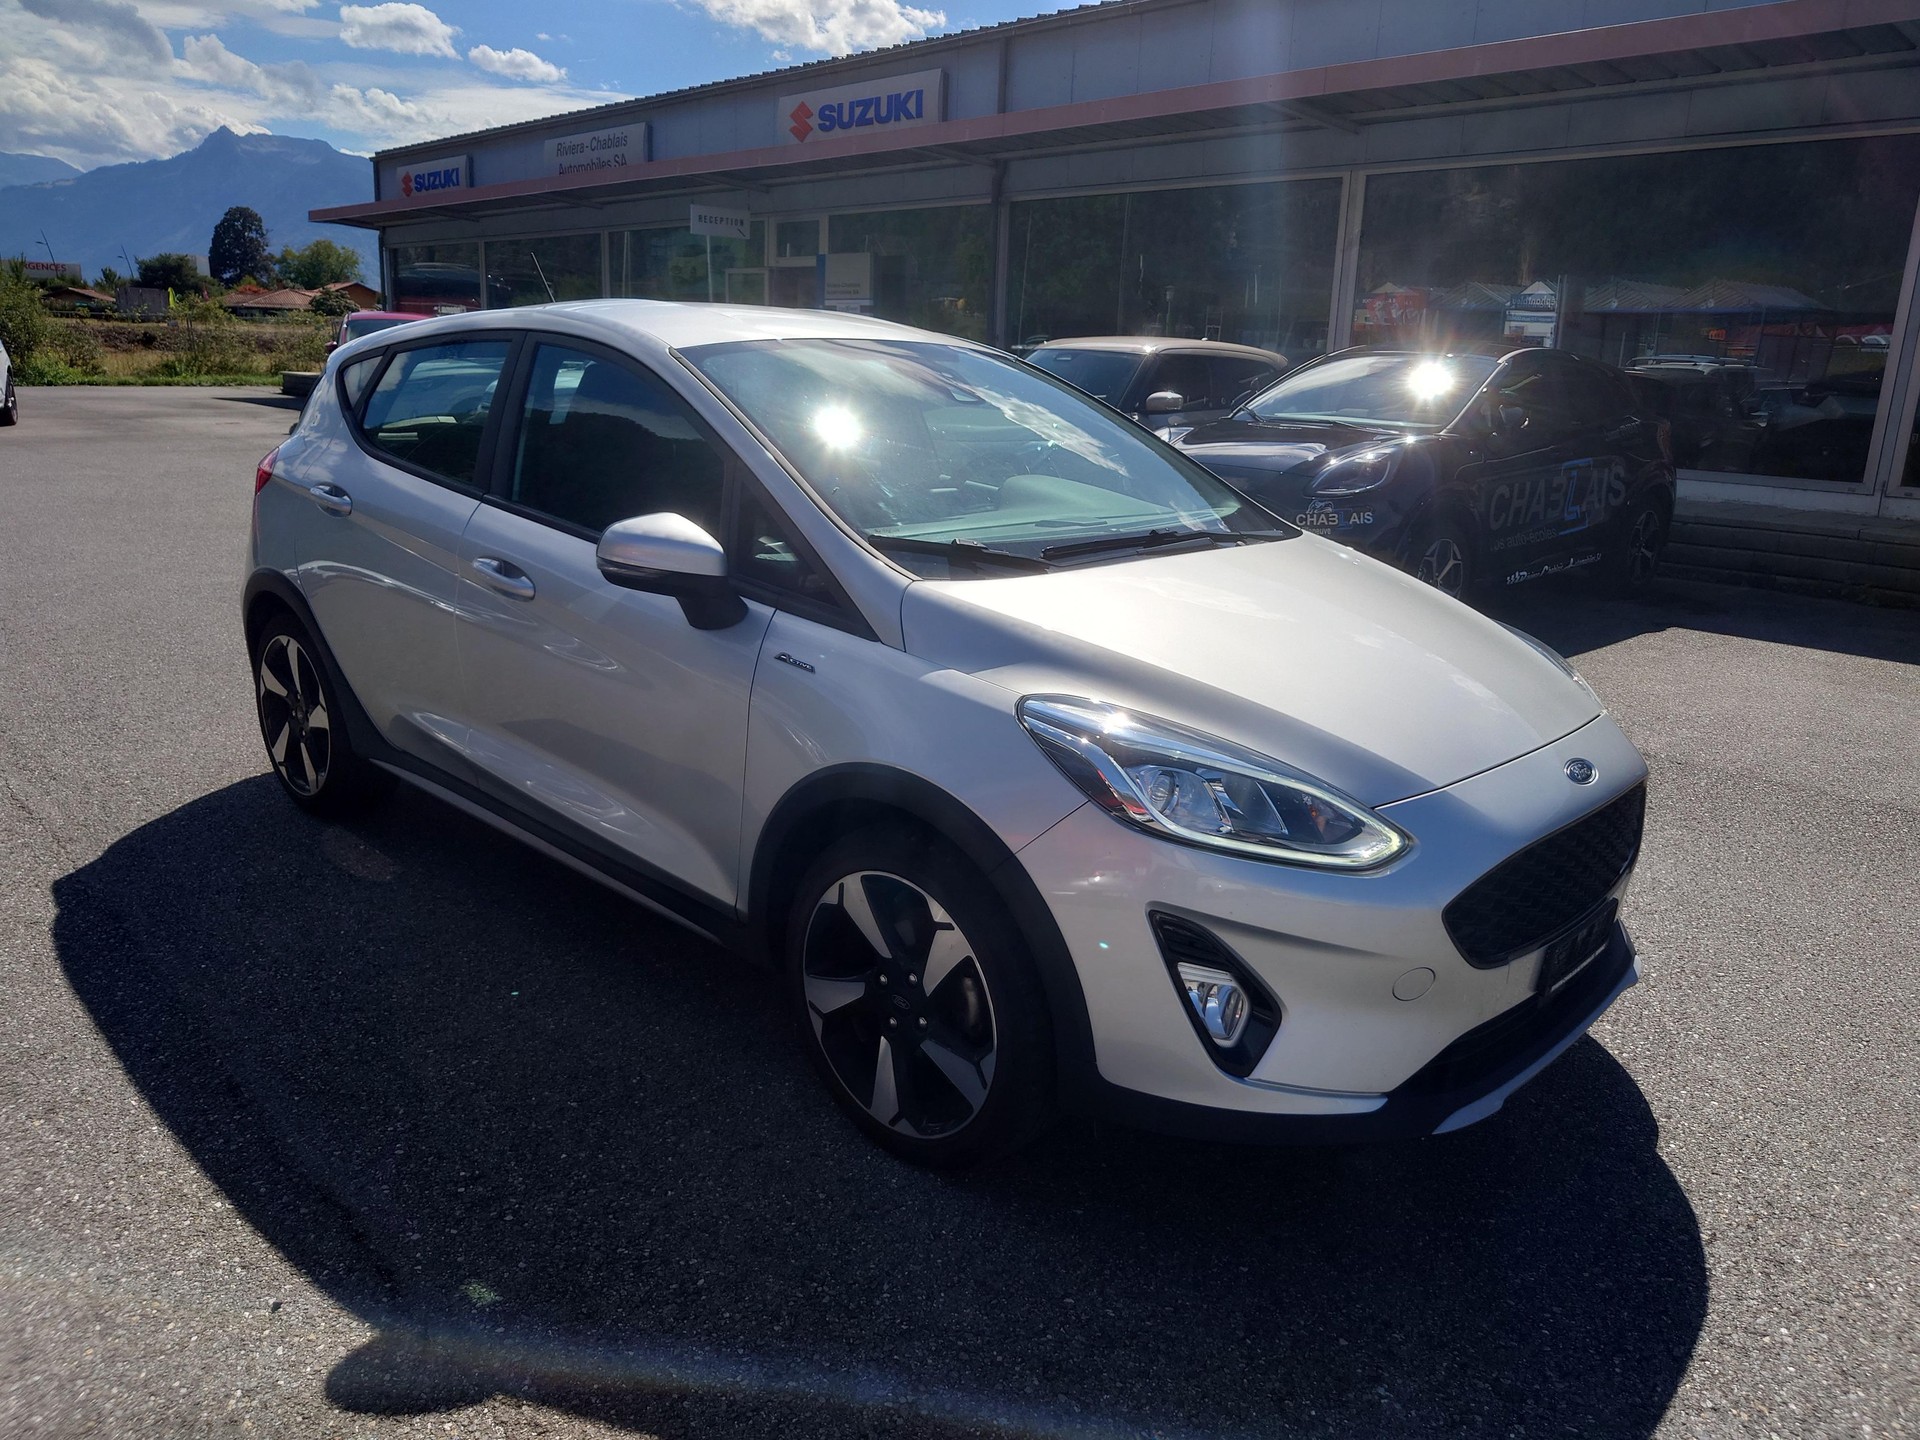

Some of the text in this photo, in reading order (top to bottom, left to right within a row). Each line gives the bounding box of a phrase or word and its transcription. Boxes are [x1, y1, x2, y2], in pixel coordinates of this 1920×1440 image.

[818, 89, 924, 132] SUZUKI
[614, 153, 627, 167] SA
[414, 167, 460, 192] SUZUKI
[698, 215, 744, 226] RECEPTION
[24, 262, 67, 272] RGENCES
